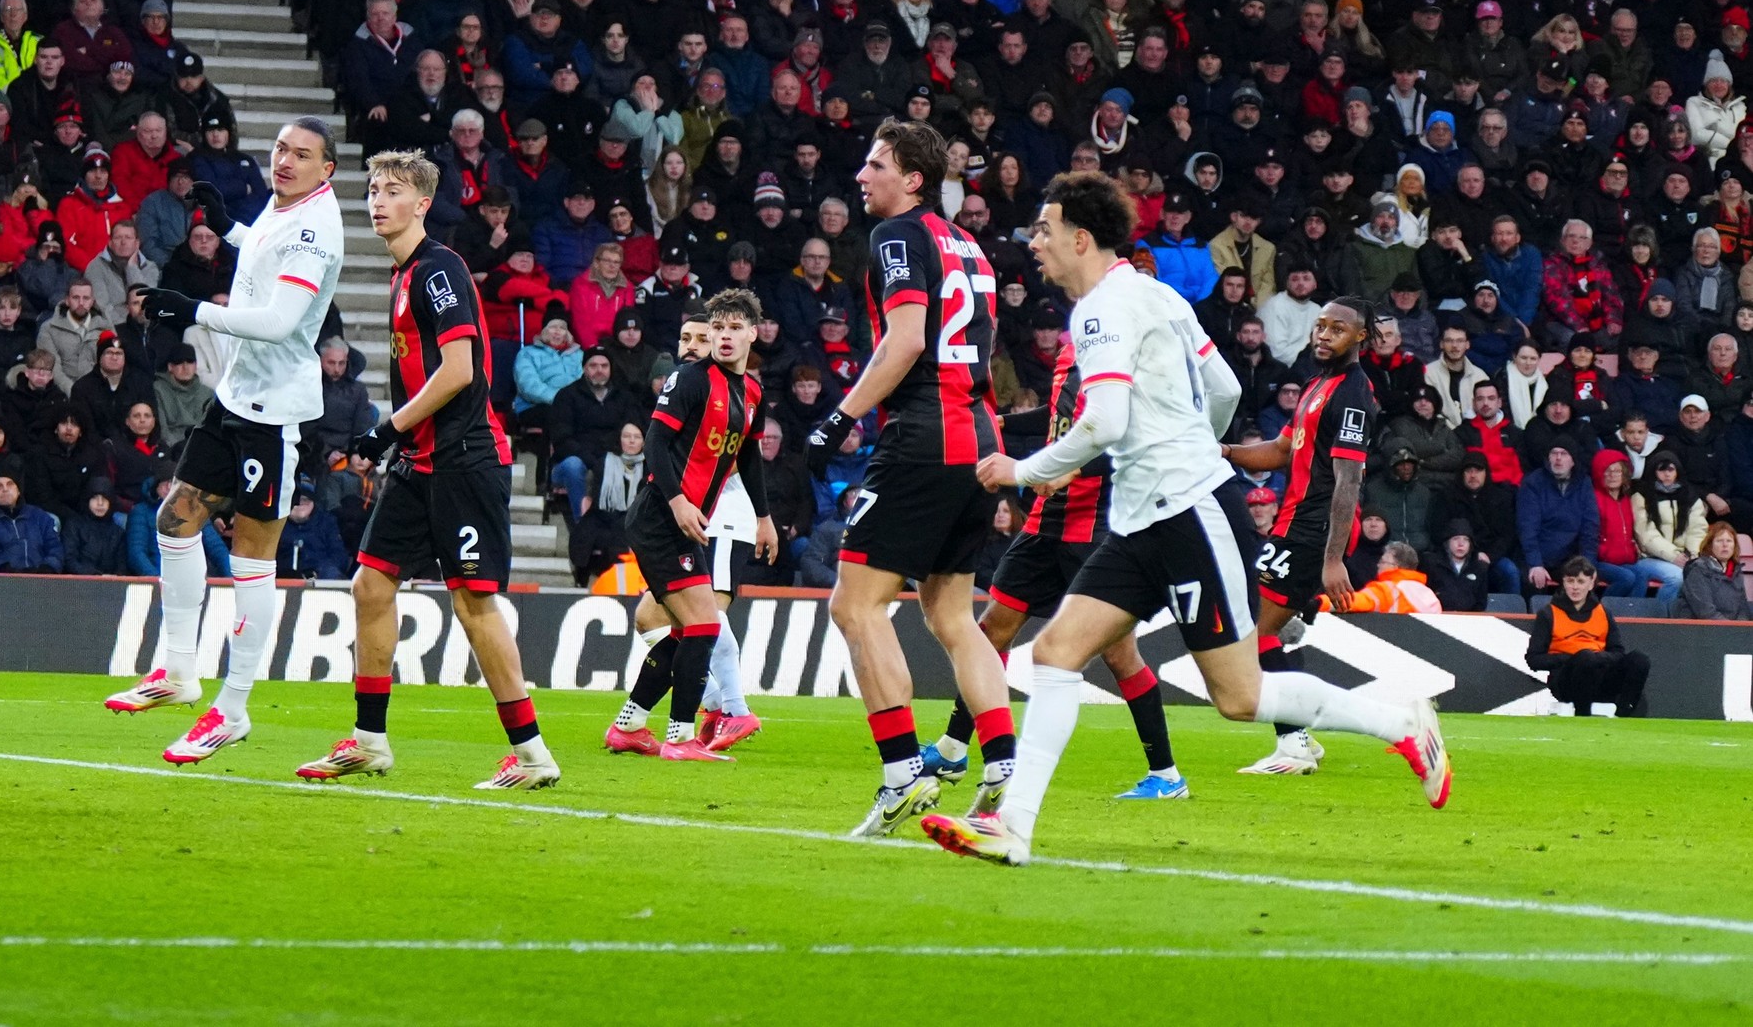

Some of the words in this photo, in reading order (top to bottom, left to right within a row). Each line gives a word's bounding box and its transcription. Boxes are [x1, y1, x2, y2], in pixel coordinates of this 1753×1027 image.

[1340, 429, 1364, 442] LEOS
[243, 457, 264, 493] 9
[846, 488, 879, 526] 7
[459, 525, 480, 561] 2
[1255, 542, 1292, 579] 24
[1168, 580, 1202, 624] 17
